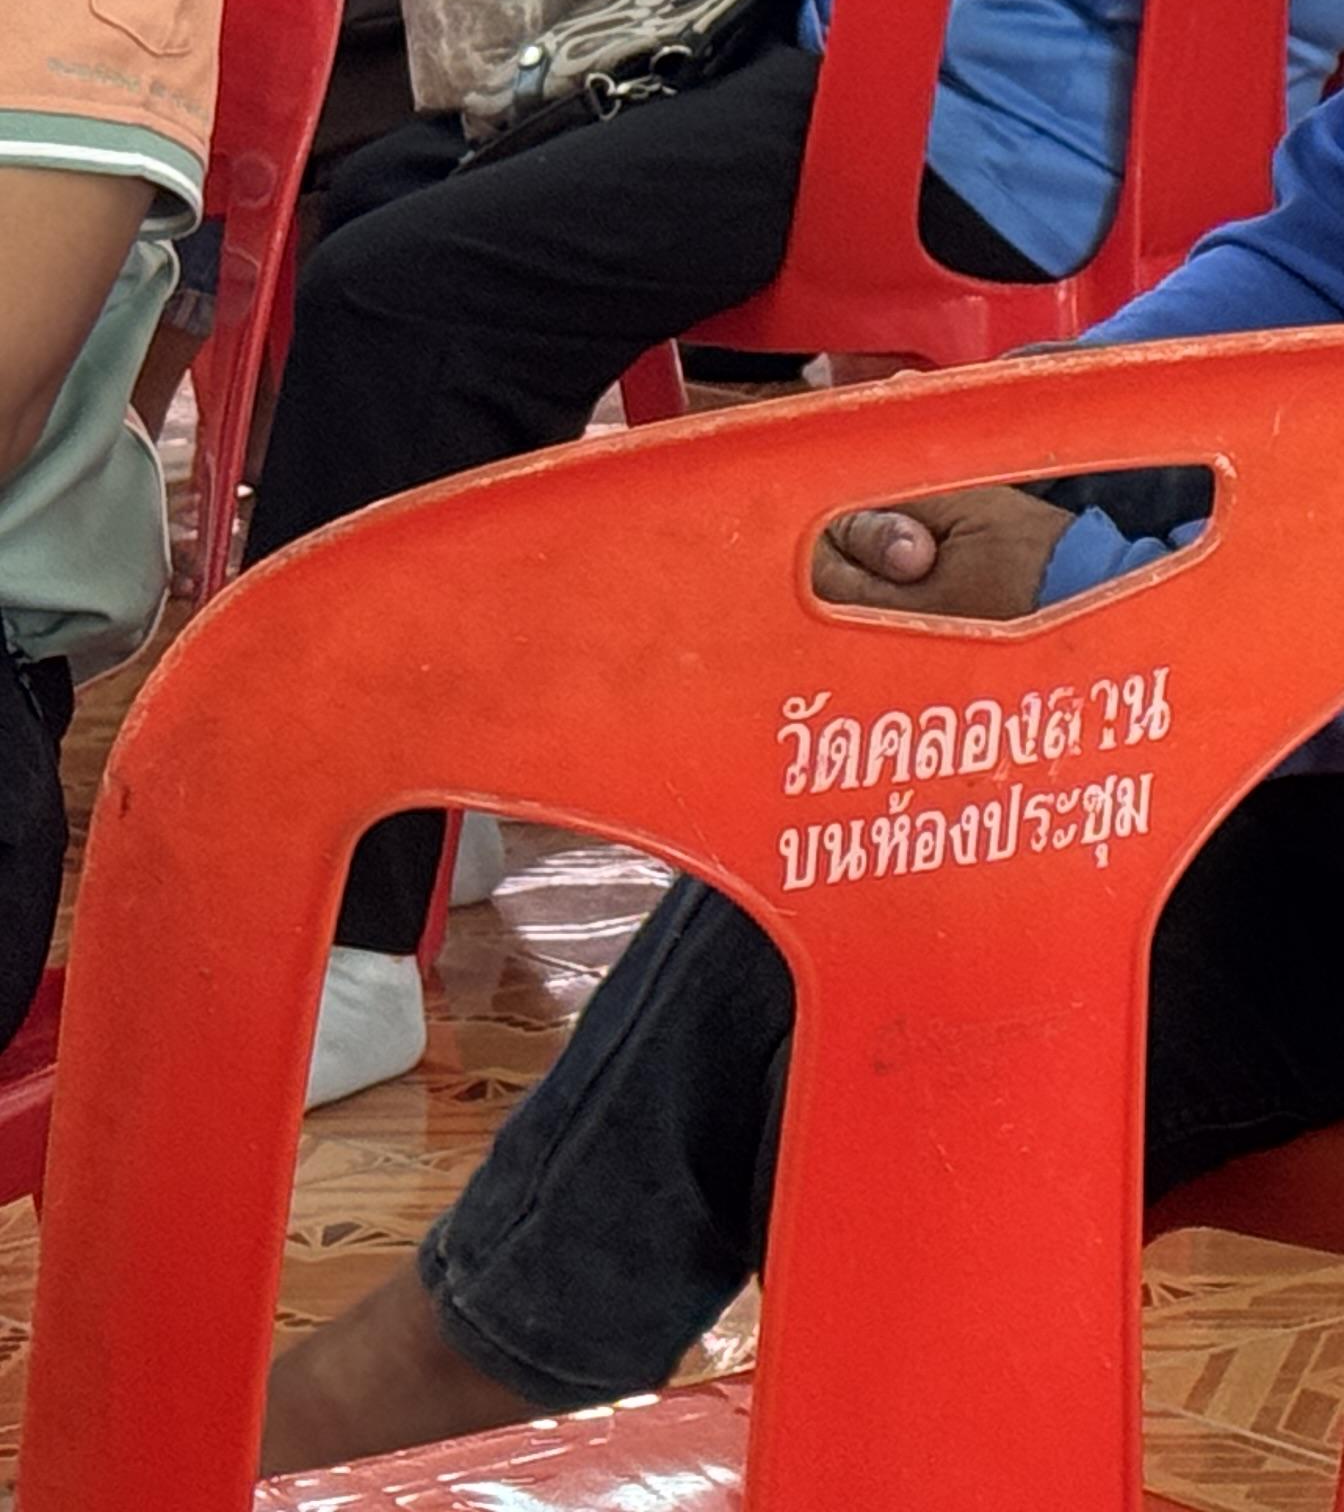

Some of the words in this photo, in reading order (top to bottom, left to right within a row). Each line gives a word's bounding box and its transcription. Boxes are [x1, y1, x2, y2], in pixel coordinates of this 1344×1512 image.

[778, 772, 1155, 891] บนห้องประชุม
